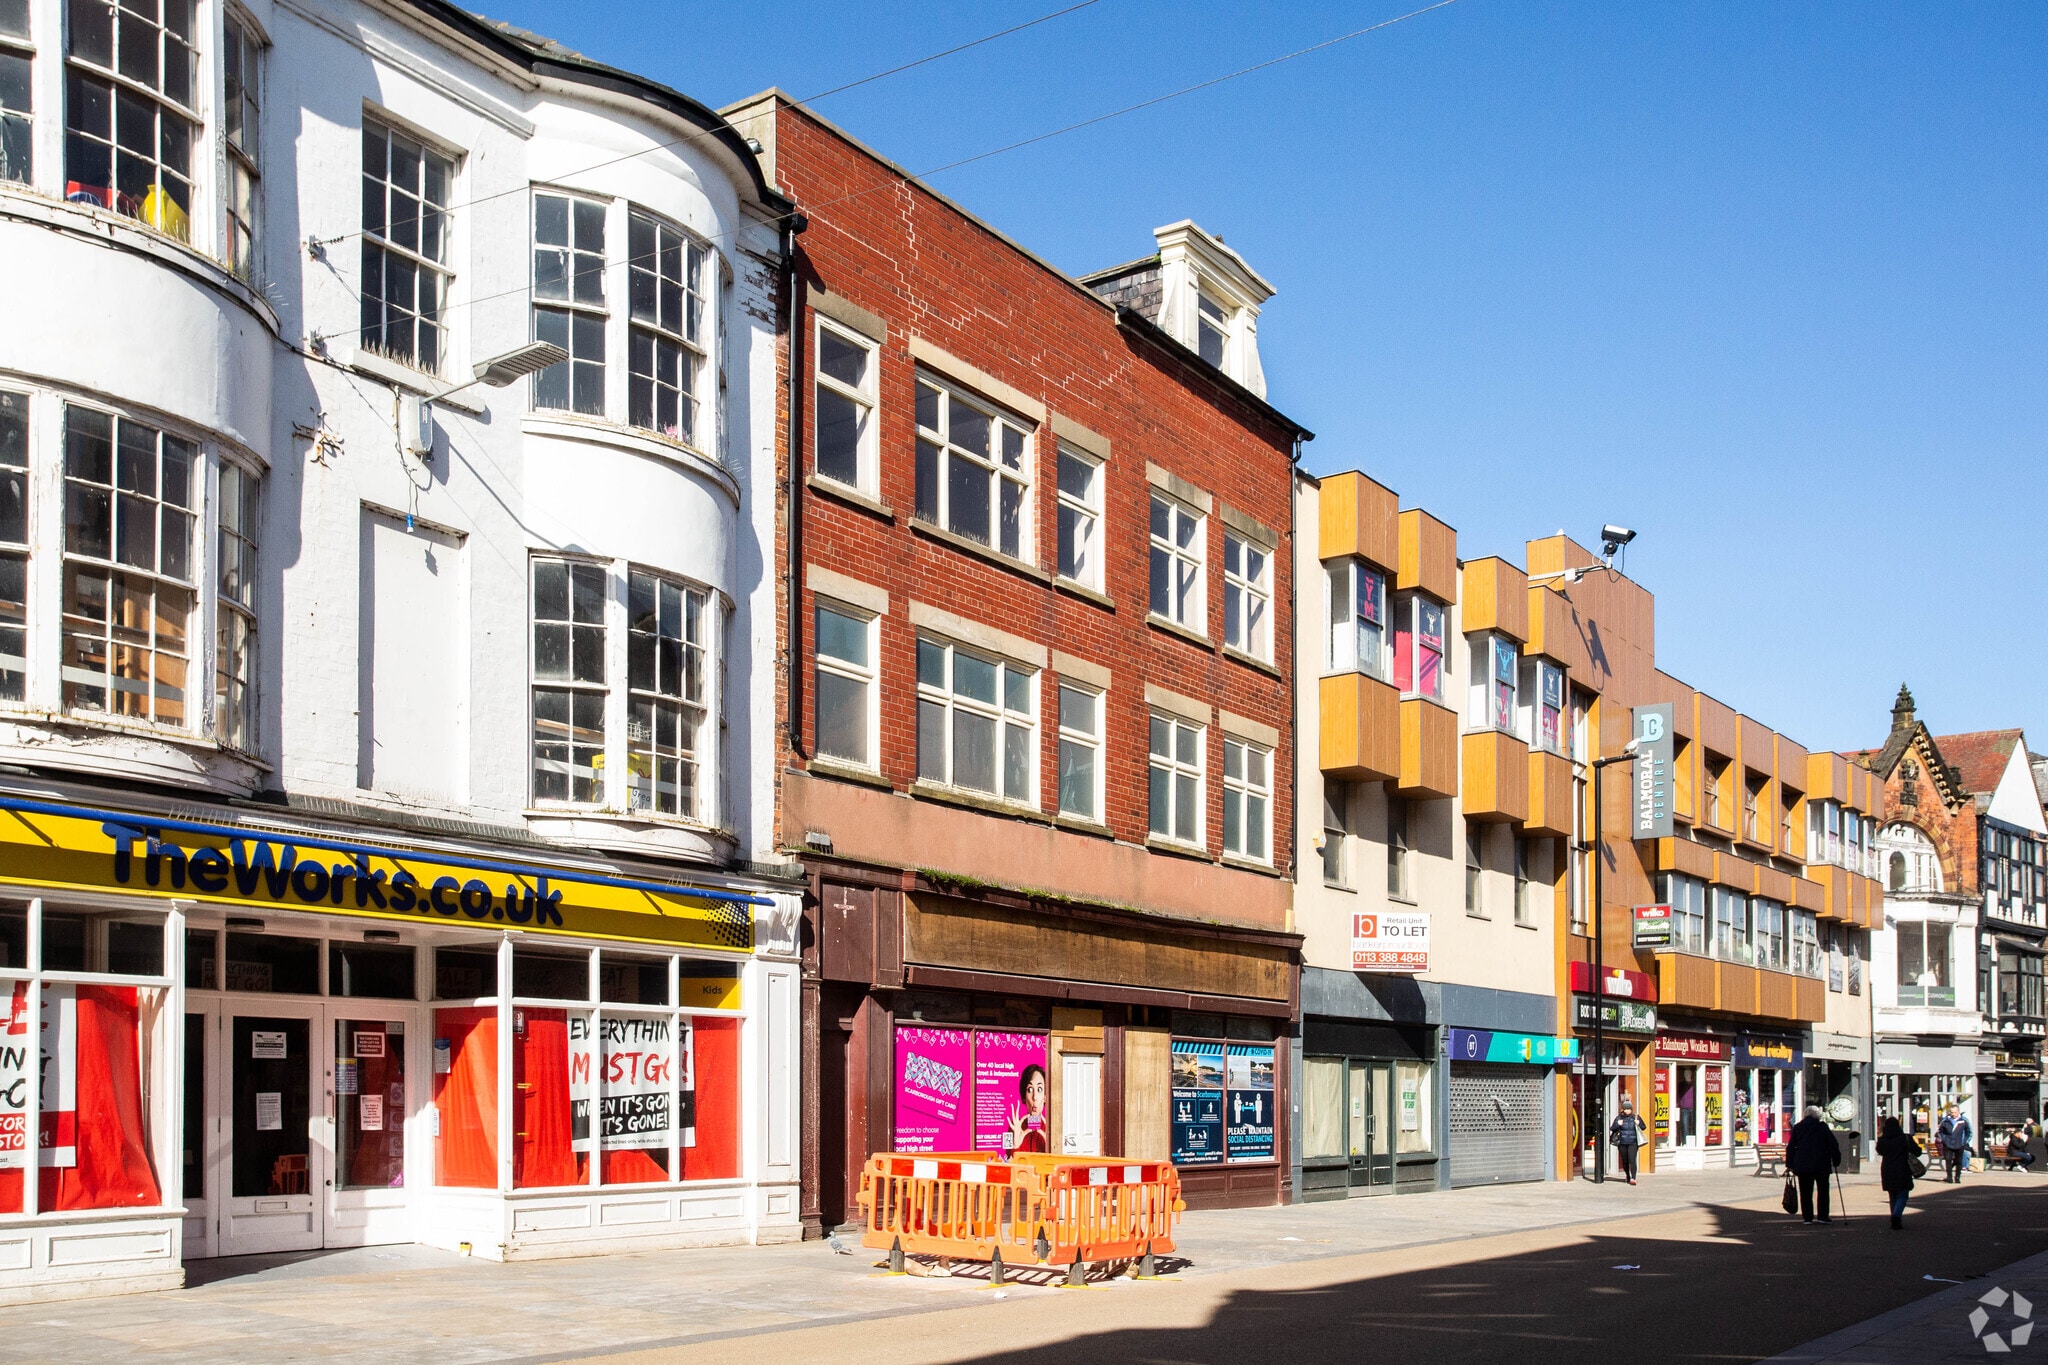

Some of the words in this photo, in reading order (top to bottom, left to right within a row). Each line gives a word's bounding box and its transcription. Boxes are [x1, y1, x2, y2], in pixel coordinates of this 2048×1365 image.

[1640, 749, 1653, 830] BALMORAL
[1654, 758, 1664, 819] CENTRE
[631, 789, 651, 802] Grea
[101, 822, 563, 926] TheWorks.co.uk
[1641, 907, 1665, 918] wilko
[1382, 926, 1400, 936] TO
[1404, 926, 1427, 937] LET
[1355, 952, 1376, 962] 0113
[1379, 953, 1398, 963] 388
[1401, 953, 1426, 963] 4848
[702, 985, 723, 995] Kids
[1622, 1015, 1647, 1028] EXPLORERS
[1469, 1041, 1475, 1051] BT
[1662, 1037, 1689, 1055] Edinburgh
[1690, 1039, 1709, 1053] Woollen
[1709, 1040, 1720, 1054] Mill
[1748, 1039, 1767, 1057] Card
[1767, 1040, 1793, 1063] Factory
[1705, 1072, 1721, 1081] CLOSING
[1707, 1083, 1720, 1092] DOWN
[905, 1087, 936, 1102] SCARBOROUGH
[935, 1097, 945, 1106] GIFT
[945, 1101, 957, 1110] CARD
[1173, 1090, 1191, 1098] Welcome
[1197, 1091, 1222, 1100] Scarborough
[619, 1094, 644, 1114] IT'S
[1658, 1107, 1669, 1117] OFF
[627, 1111, 669, 1132] GONE!
[1227, 1127, 1247, 1135] PLEASE
[1247, 1126, 1273, 1135] MAINTAIN
[894, 1136, 922, 1144] Supporting
[1227, 1135, 1245, 1144] SOCIAL
[1245, 1135, 1273, 1143] DISTANCING
[906, 1145, 918, 1153] high
